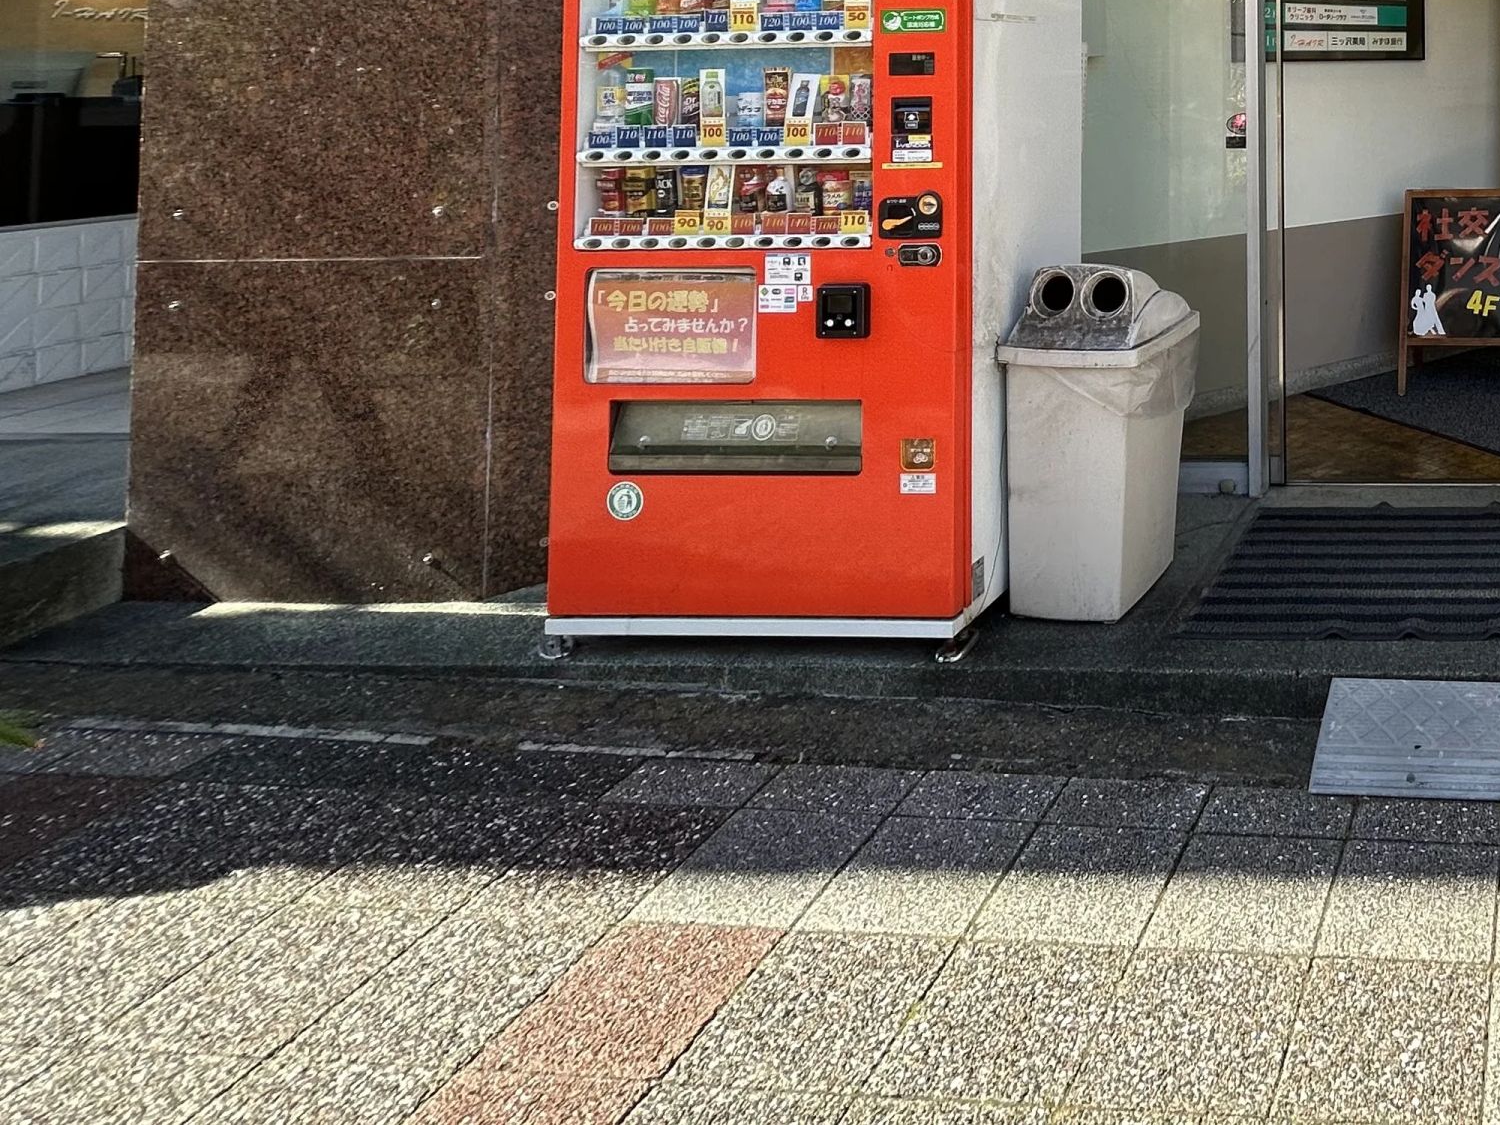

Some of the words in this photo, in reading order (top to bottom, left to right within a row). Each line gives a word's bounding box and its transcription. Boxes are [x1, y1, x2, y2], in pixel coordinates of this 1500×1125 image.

[707, 14, 726, 24] 110
[733, 14, 754, 24] 110
[848, 12, 866, 21] 50
[597, 21, 616, 31] 100
[624, 21, 643, 30] 100
[652, 19, 671, 29] 100
[679, 19, 697, 28] 100
[619, 130, 637, 139] 110
[646, 130, 665, 139] 110
[675, 129, 693, 139] 110
[703, 128, 722, 137] 100
[731, 132, 750, 141] 100
[759, 132, 777, 141] 100
[787, 127, 807, 137] 100
[590, 134, 610, 144] 100
[677, 217, 697, 227] 90
[707, 220, 724, 230] 90
[844, 215, 865, 225] 110
[1415, 207, 1489, 242] 社交
[593, 224, 612, 232] 100
[621, 223, 640, 232] 100
[1466, 289, 1500, 317] 4F
